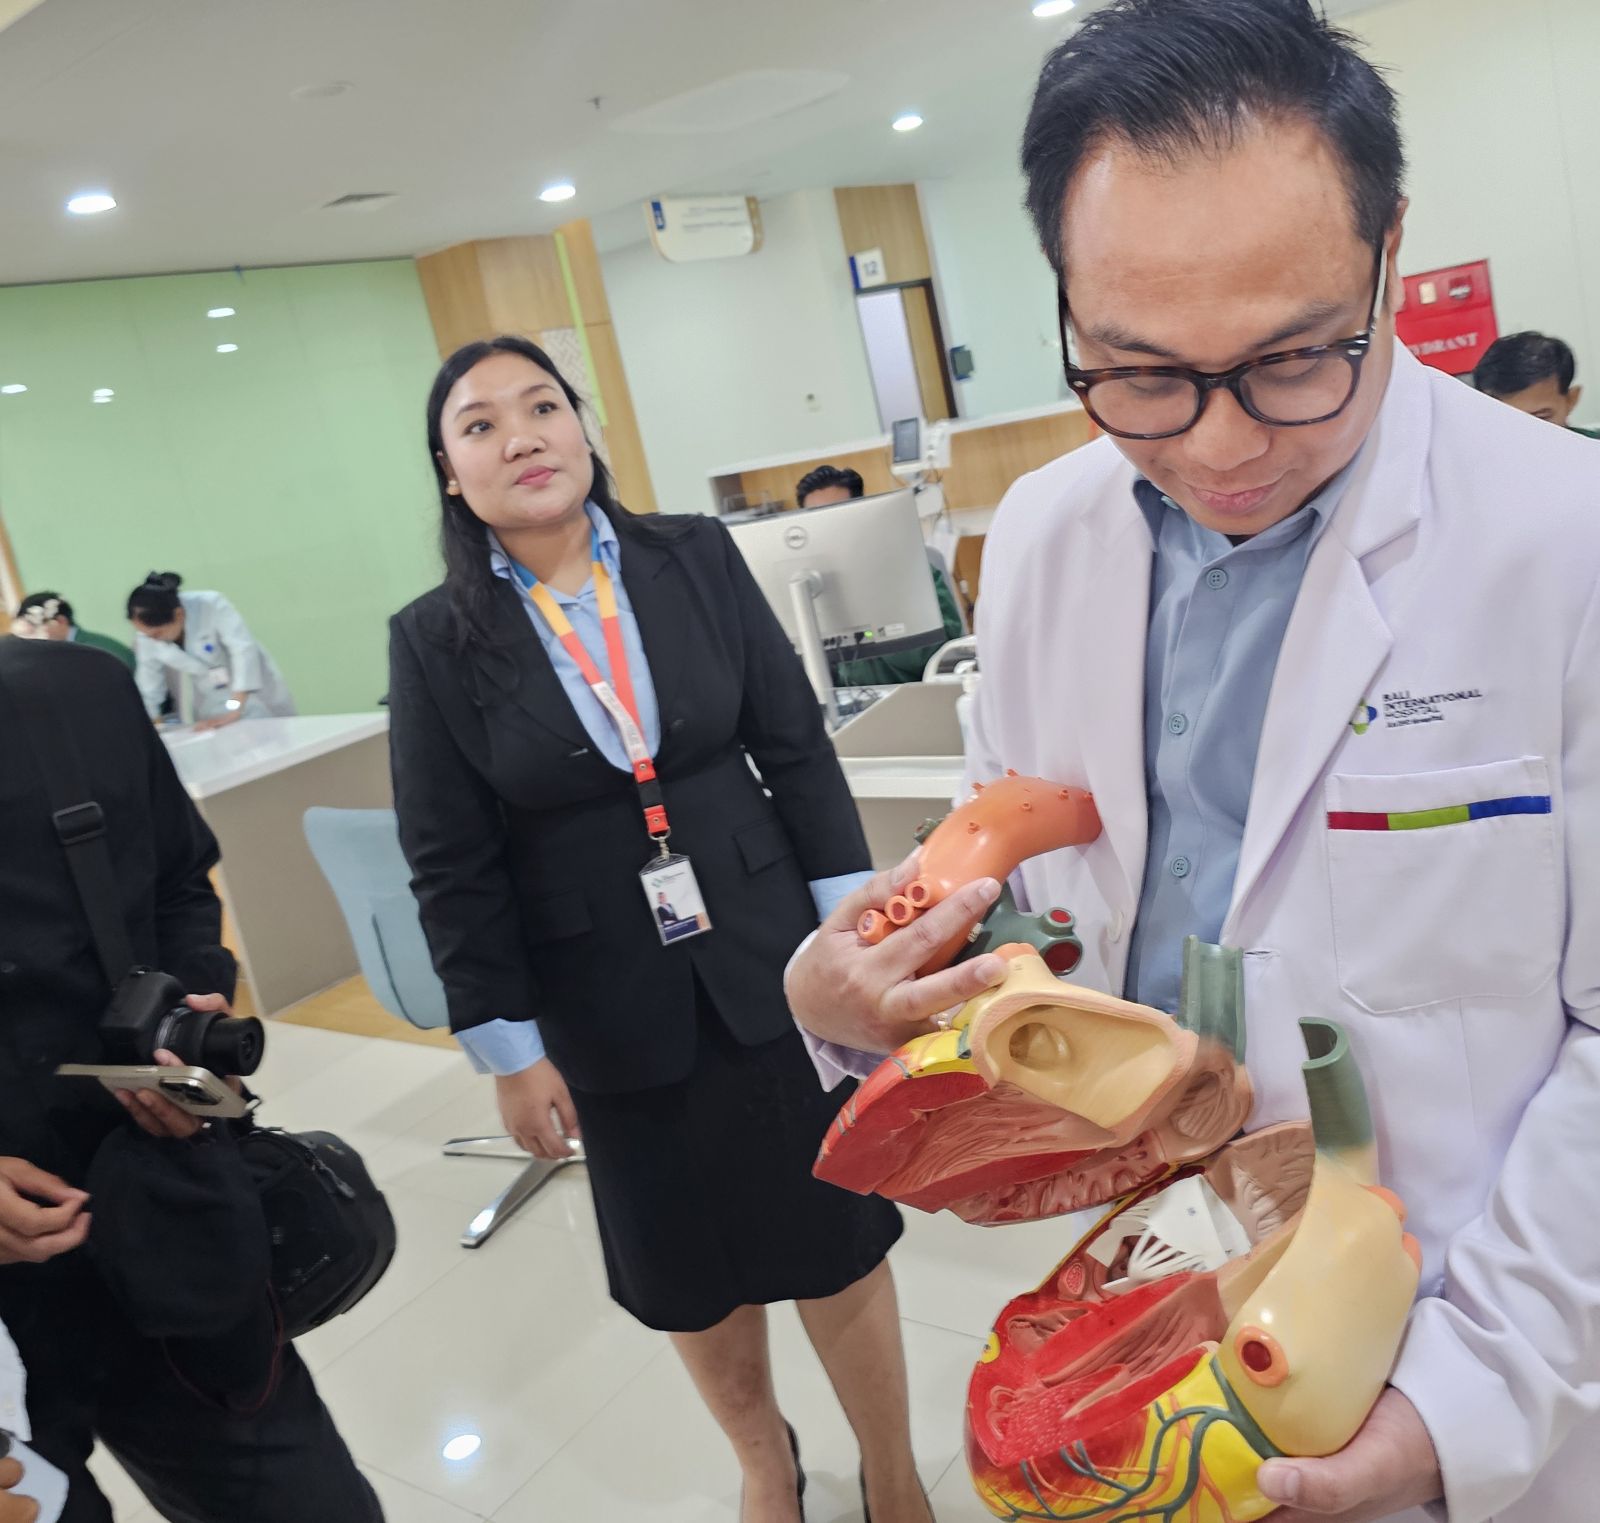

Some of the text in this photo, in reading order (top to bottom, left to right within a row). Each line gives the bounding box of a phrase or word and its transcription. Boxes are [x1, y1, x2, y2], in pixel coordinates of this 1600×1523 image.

[864, 260, 880, 277] 12
[1405, 331, 1478, 356] YDRANT
[1383, 689, 1482, 710] INTERNATIONAL
[1384, 705, 1441, 719] HOSPITAL
